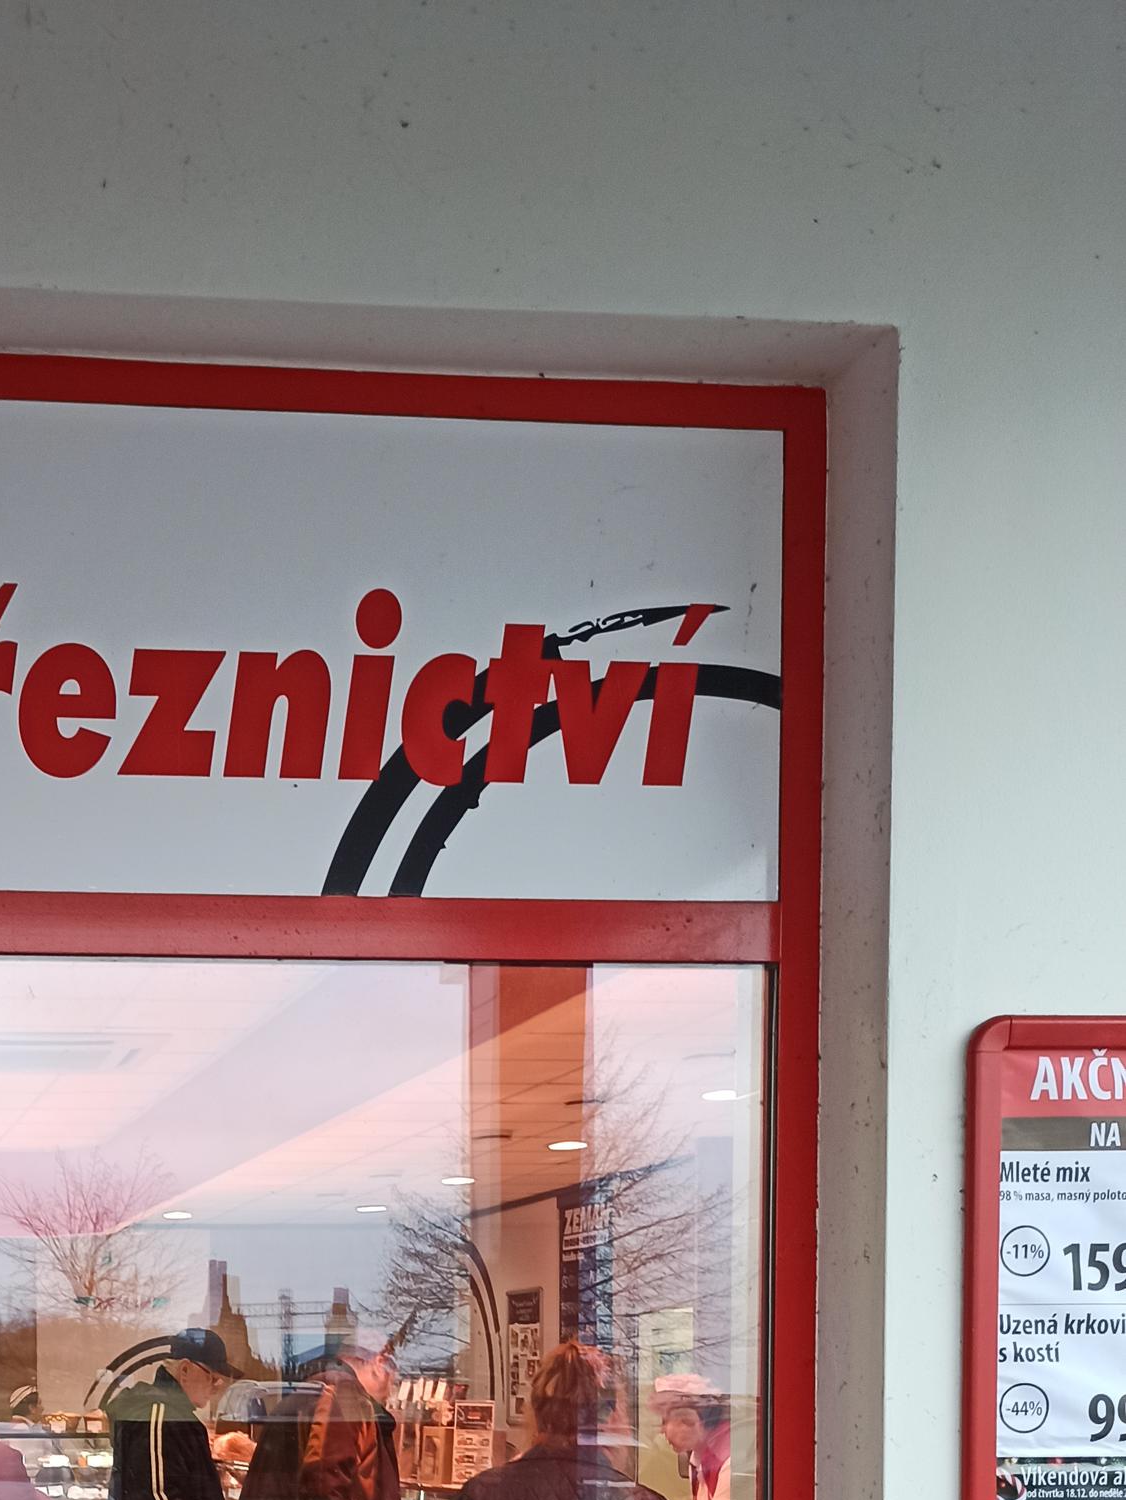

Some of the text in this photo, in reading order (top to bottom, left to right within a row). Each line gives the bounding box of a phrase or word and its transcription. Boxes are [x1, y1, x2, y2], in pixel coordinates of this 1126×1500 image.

[1089, 1122, 1122, 1148] NA
[999, 1160, 1091, 1183] Mleté mix
[1025, 1191, 1055, 1203] masa,
[1056, 1188, 1091, 1204] masný
[1006, 1243, 1045, 1259] -11%
[999, 1312, 1126, 1335] Uzená krkovi
[998, 1341, 1060, 1363] s kostí
[1005, 1400, 1043, 1416] -44%
[1020, 1465, 1109, 1486] Víkendová
